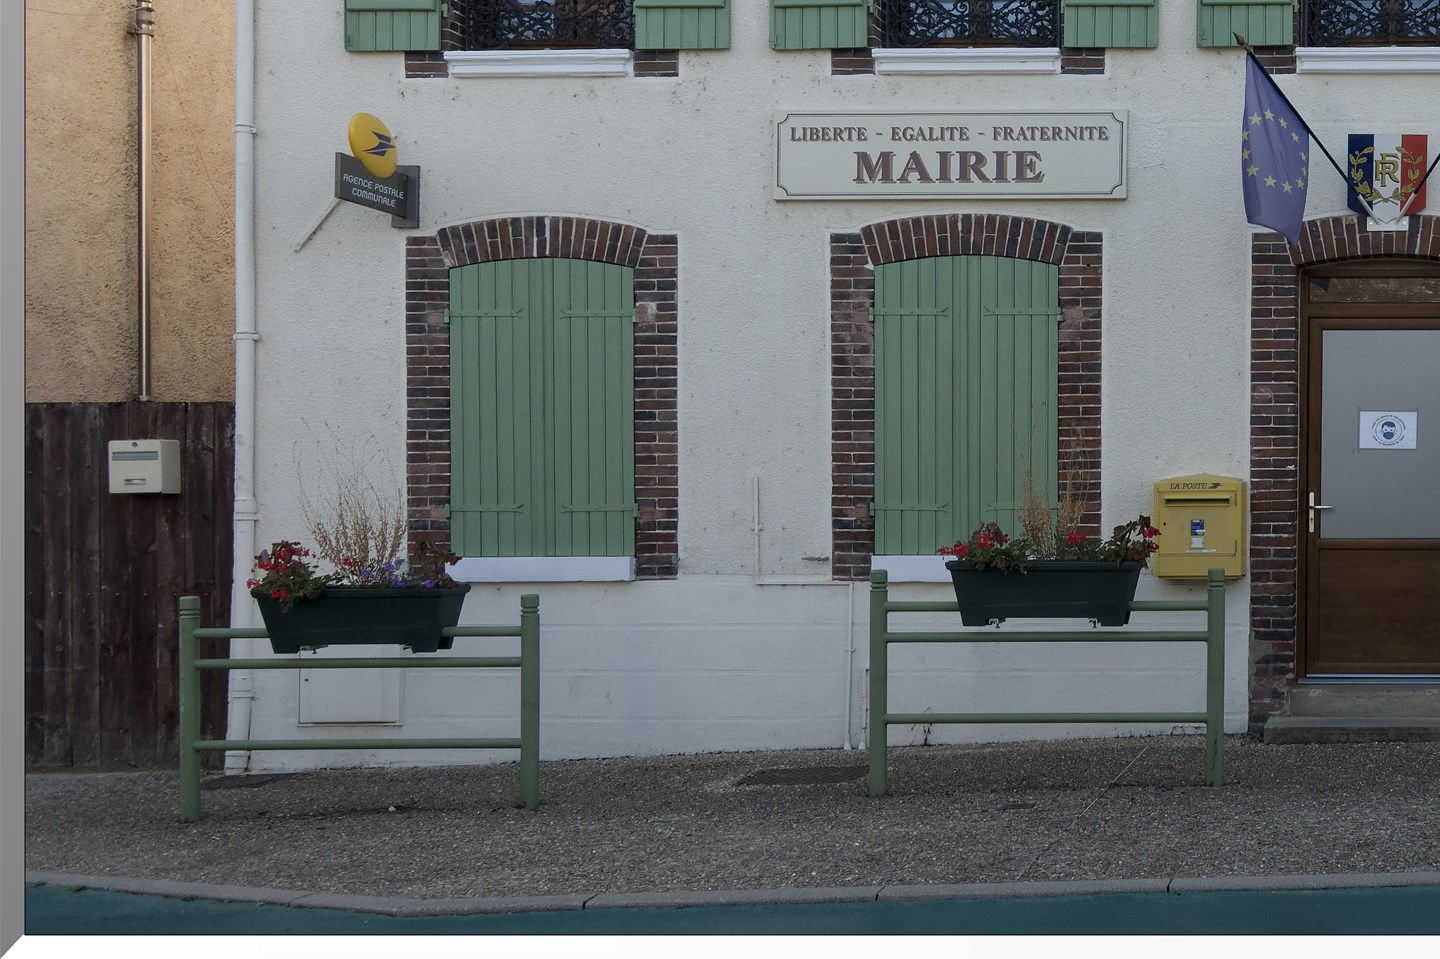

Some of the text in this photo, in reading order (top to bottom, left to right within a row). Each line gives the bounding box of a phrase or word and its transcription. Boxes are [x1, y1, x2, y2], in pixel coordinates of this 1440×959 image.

[790, 126, 868, 142] LIBERTE
[890, 126, 970, 142] EGALITE
[992, 126, 1110, 142] FRATERNITE
[852, 150, 1045, 184] MAIRIE
[343, 173, 404, 199] AGENCE POSTALE
[352, 187, 396, 207] COMMUNALE
